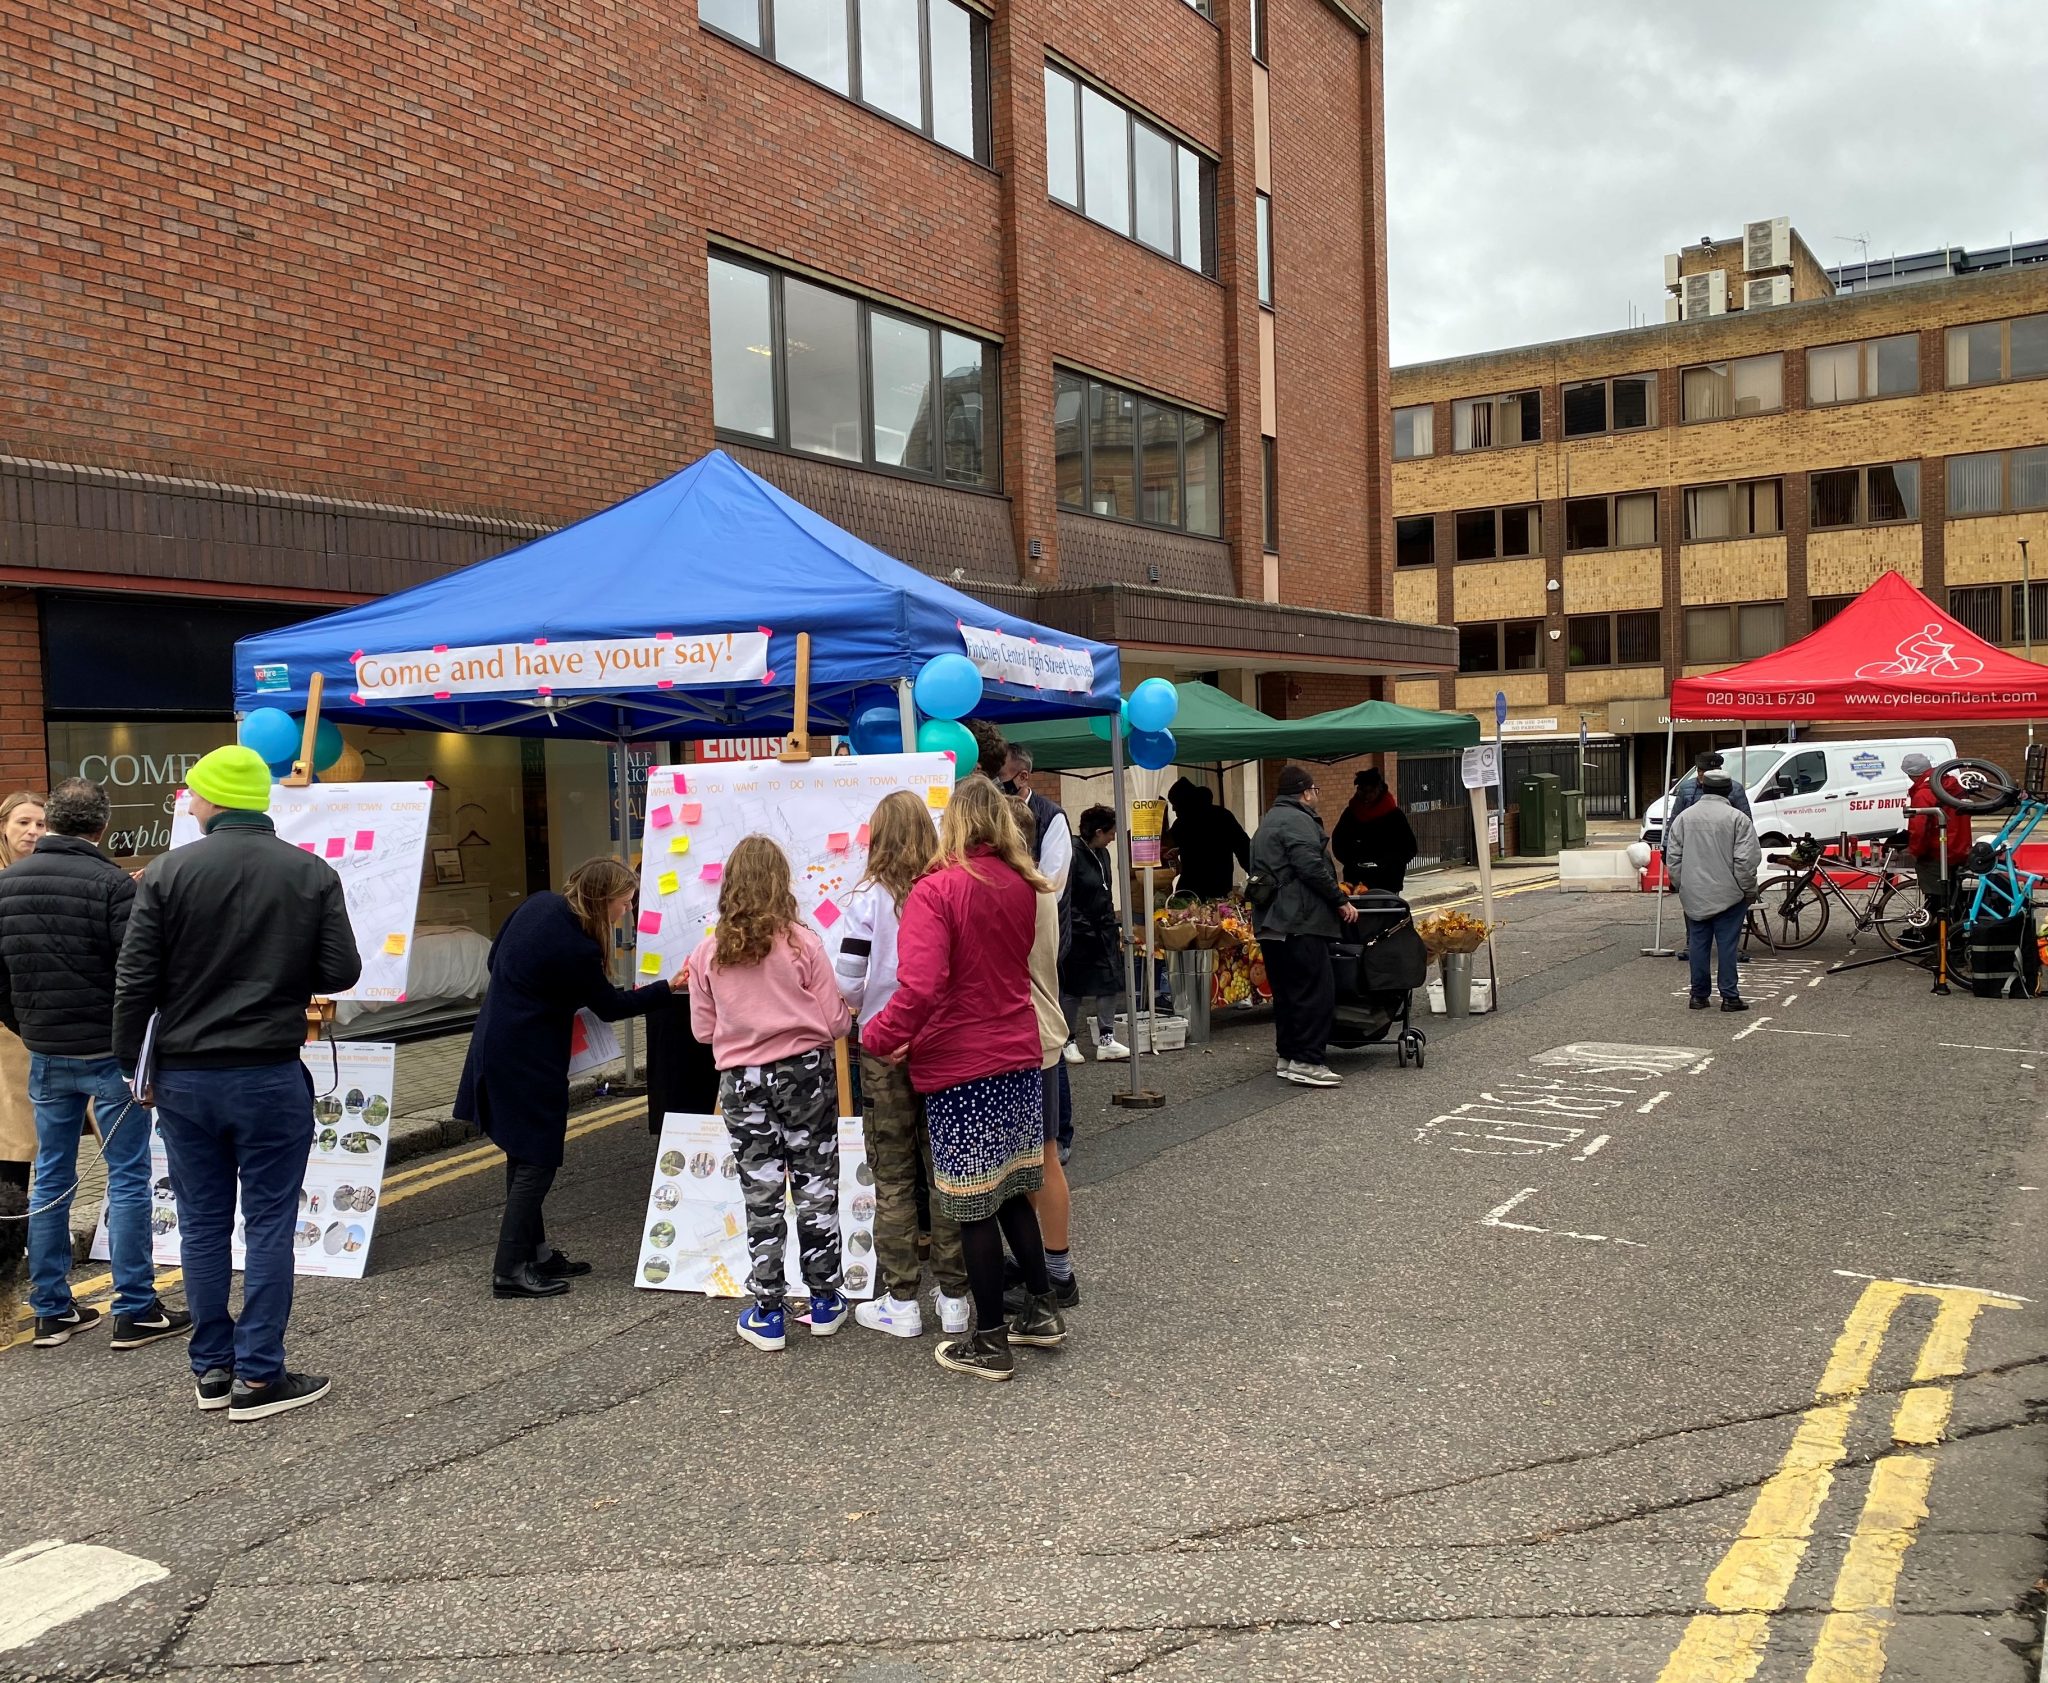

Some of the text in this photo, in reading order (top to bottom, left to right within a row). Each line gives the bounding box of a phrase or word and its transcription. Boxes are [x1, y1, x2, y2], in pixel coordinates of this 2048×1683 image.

[358, 632, 733, 688] Come and have your say!
[1001, 643, 1027, 668] Central
[1028, 649, 1044, 676] High
[1045, 654, 1069, 675] Street
[1706, 692, 1815, 705] 020 3031 6730
[1844, 691, 2038, 707] www.cycleconfident.com
[1620, 718, 1626, 726] 2
[705, 784, 724, 793] YOU
[732, 781, 760, 792] WANT
[767, 780, 781, 791] TO
[790, 779, 805, 789] DO
[814, 779, 824, 788] IN
[833, 777, 859, 787] YOUR
[868, 775, 898, 785] TOWN
[907, 774, 949, 785] CENTRE?
[272, 802, 426, 813] TO DO IN YOUR TOWN CENTRE?
[1132, 800, 1158, 810] GROW
[1849, 798, 1907, 811] SELF DRIVE
